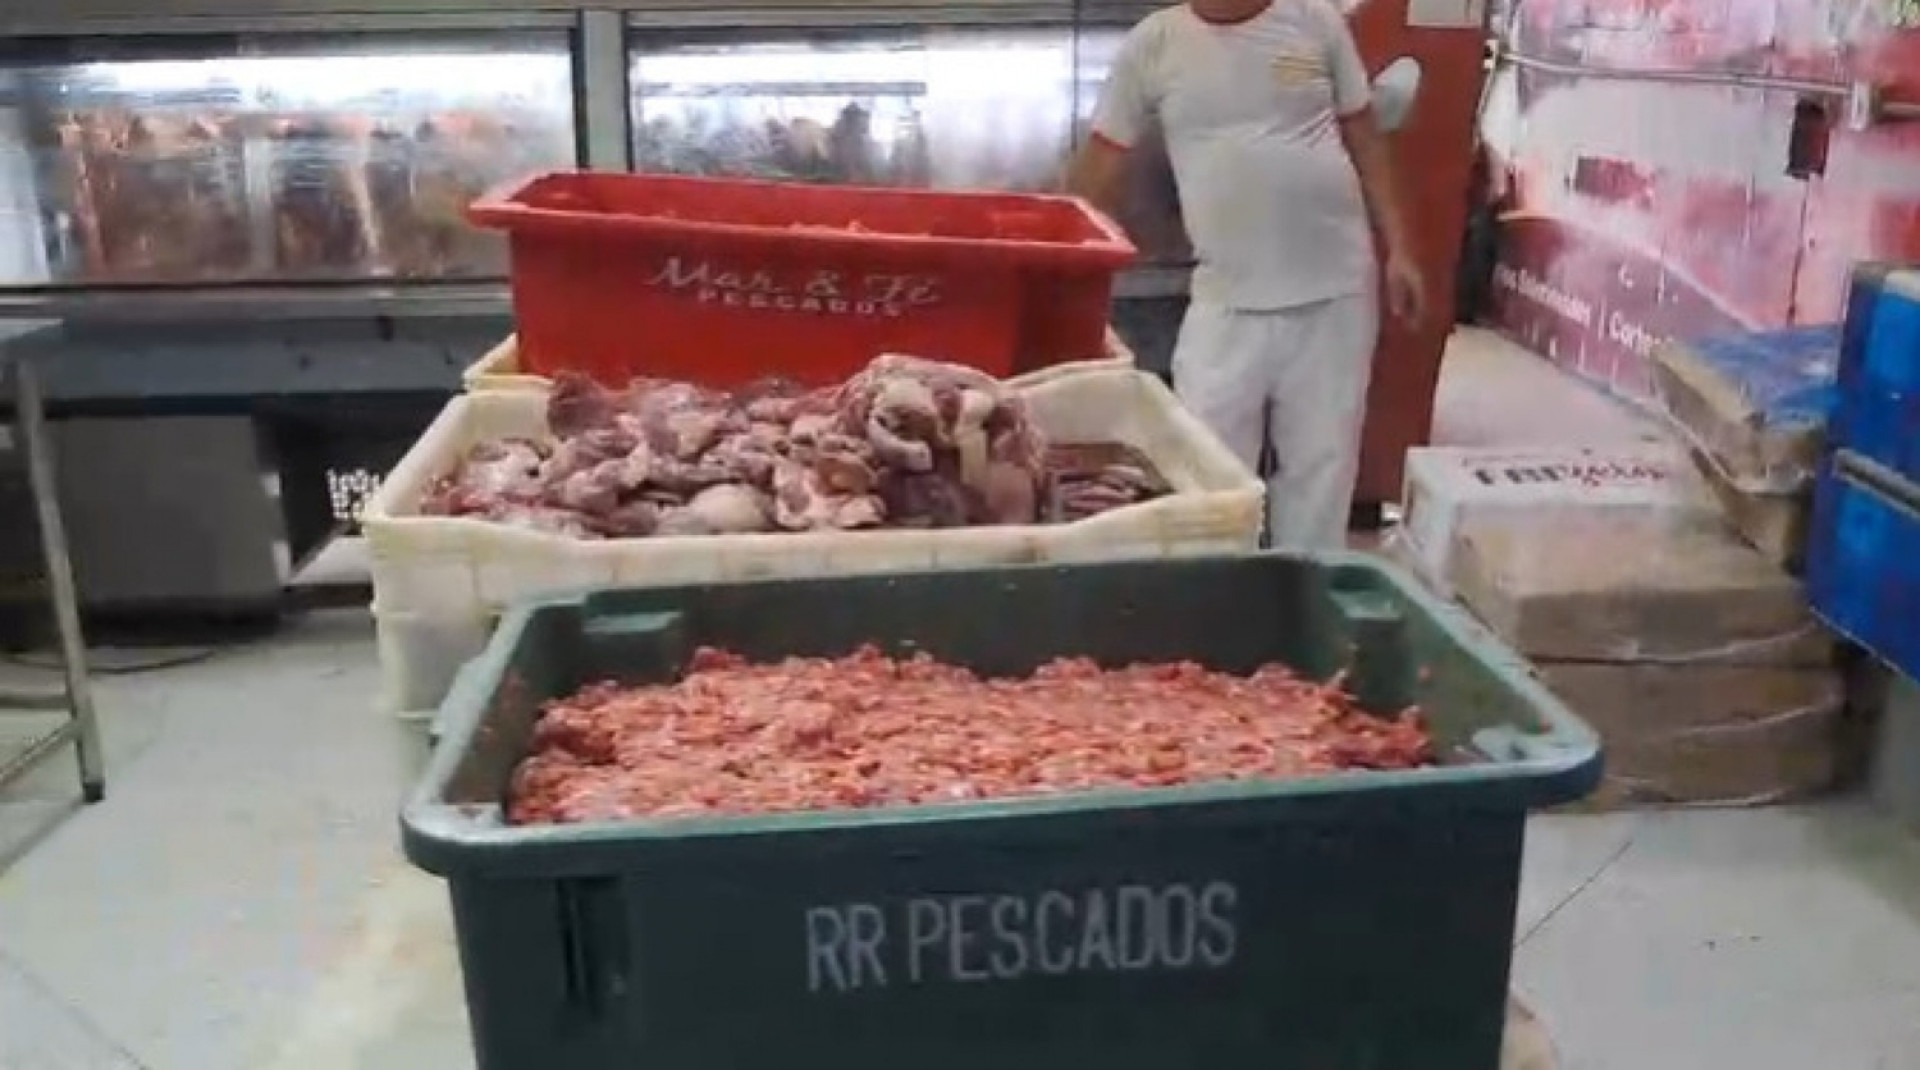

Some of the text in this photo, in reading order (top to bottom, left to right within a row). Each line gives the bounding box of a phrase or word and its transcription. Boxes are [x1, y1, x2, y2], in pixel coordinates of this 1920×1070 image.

[643, 256, 785, 290] Mar
[805, 269, 840, 295] &
[699, 287, 904, 318] PESCADOS
[805, 881, 1239, 992] RR PESCADOS
